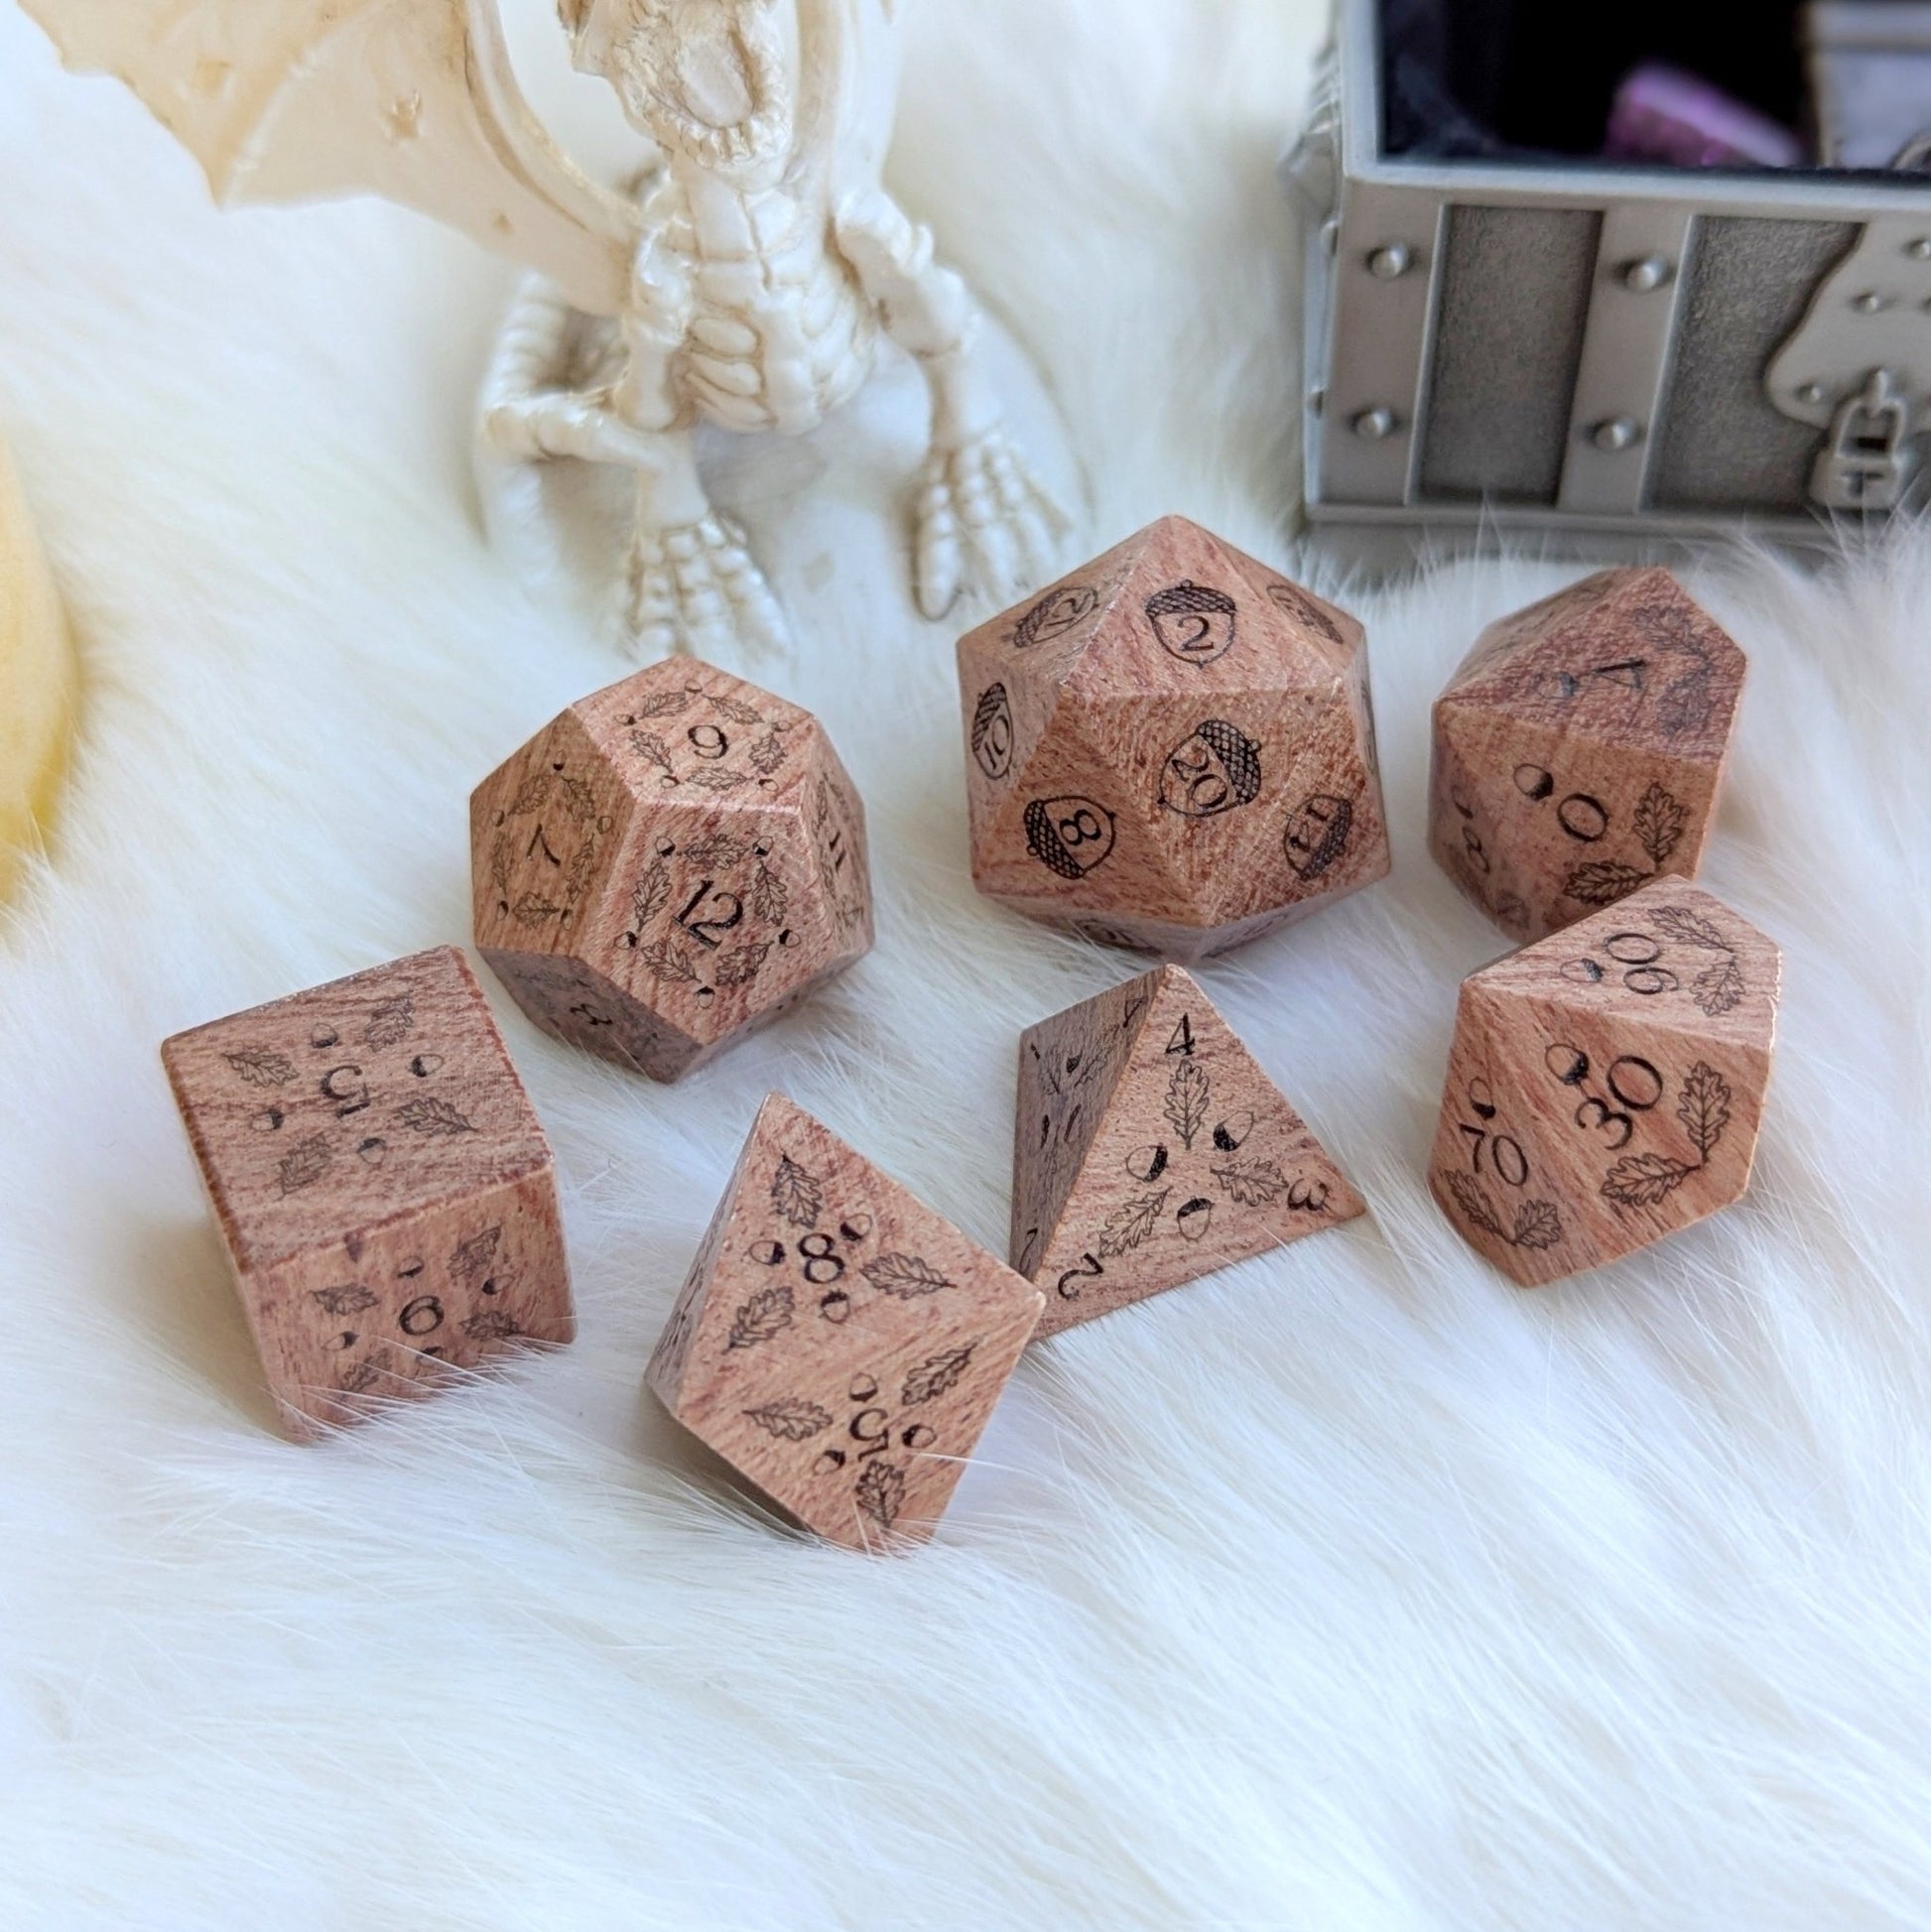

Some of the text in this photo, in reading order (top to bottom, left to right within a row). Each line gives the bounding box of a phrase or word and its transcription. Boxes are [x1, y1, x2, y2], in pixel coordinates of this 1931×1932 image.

[1178, 616, 1215, 652] 2
[688, 725, 728, 759] 9
[985, 718, 1011, 768] 10
[1172, 744, 1228, 809] 20
[1059, 811, 1098, 844] 8
[1556, 792, 1609, 842] 0
[672, 880, 743, 951] 12
[1165, 1012, 1196, 1055] 4
[321, 1065, 371, 1120] 5
[1576, 1055, 1664, 1150] 30
[1460, 1127, 1528, 1187] 70
[1287, 1178, 1330, 1212] 3
[797, 1232, 846, 1285] 8
[1057, 1252, 1104, 1300] 2
[849, 1408, 890, 1462] 5
